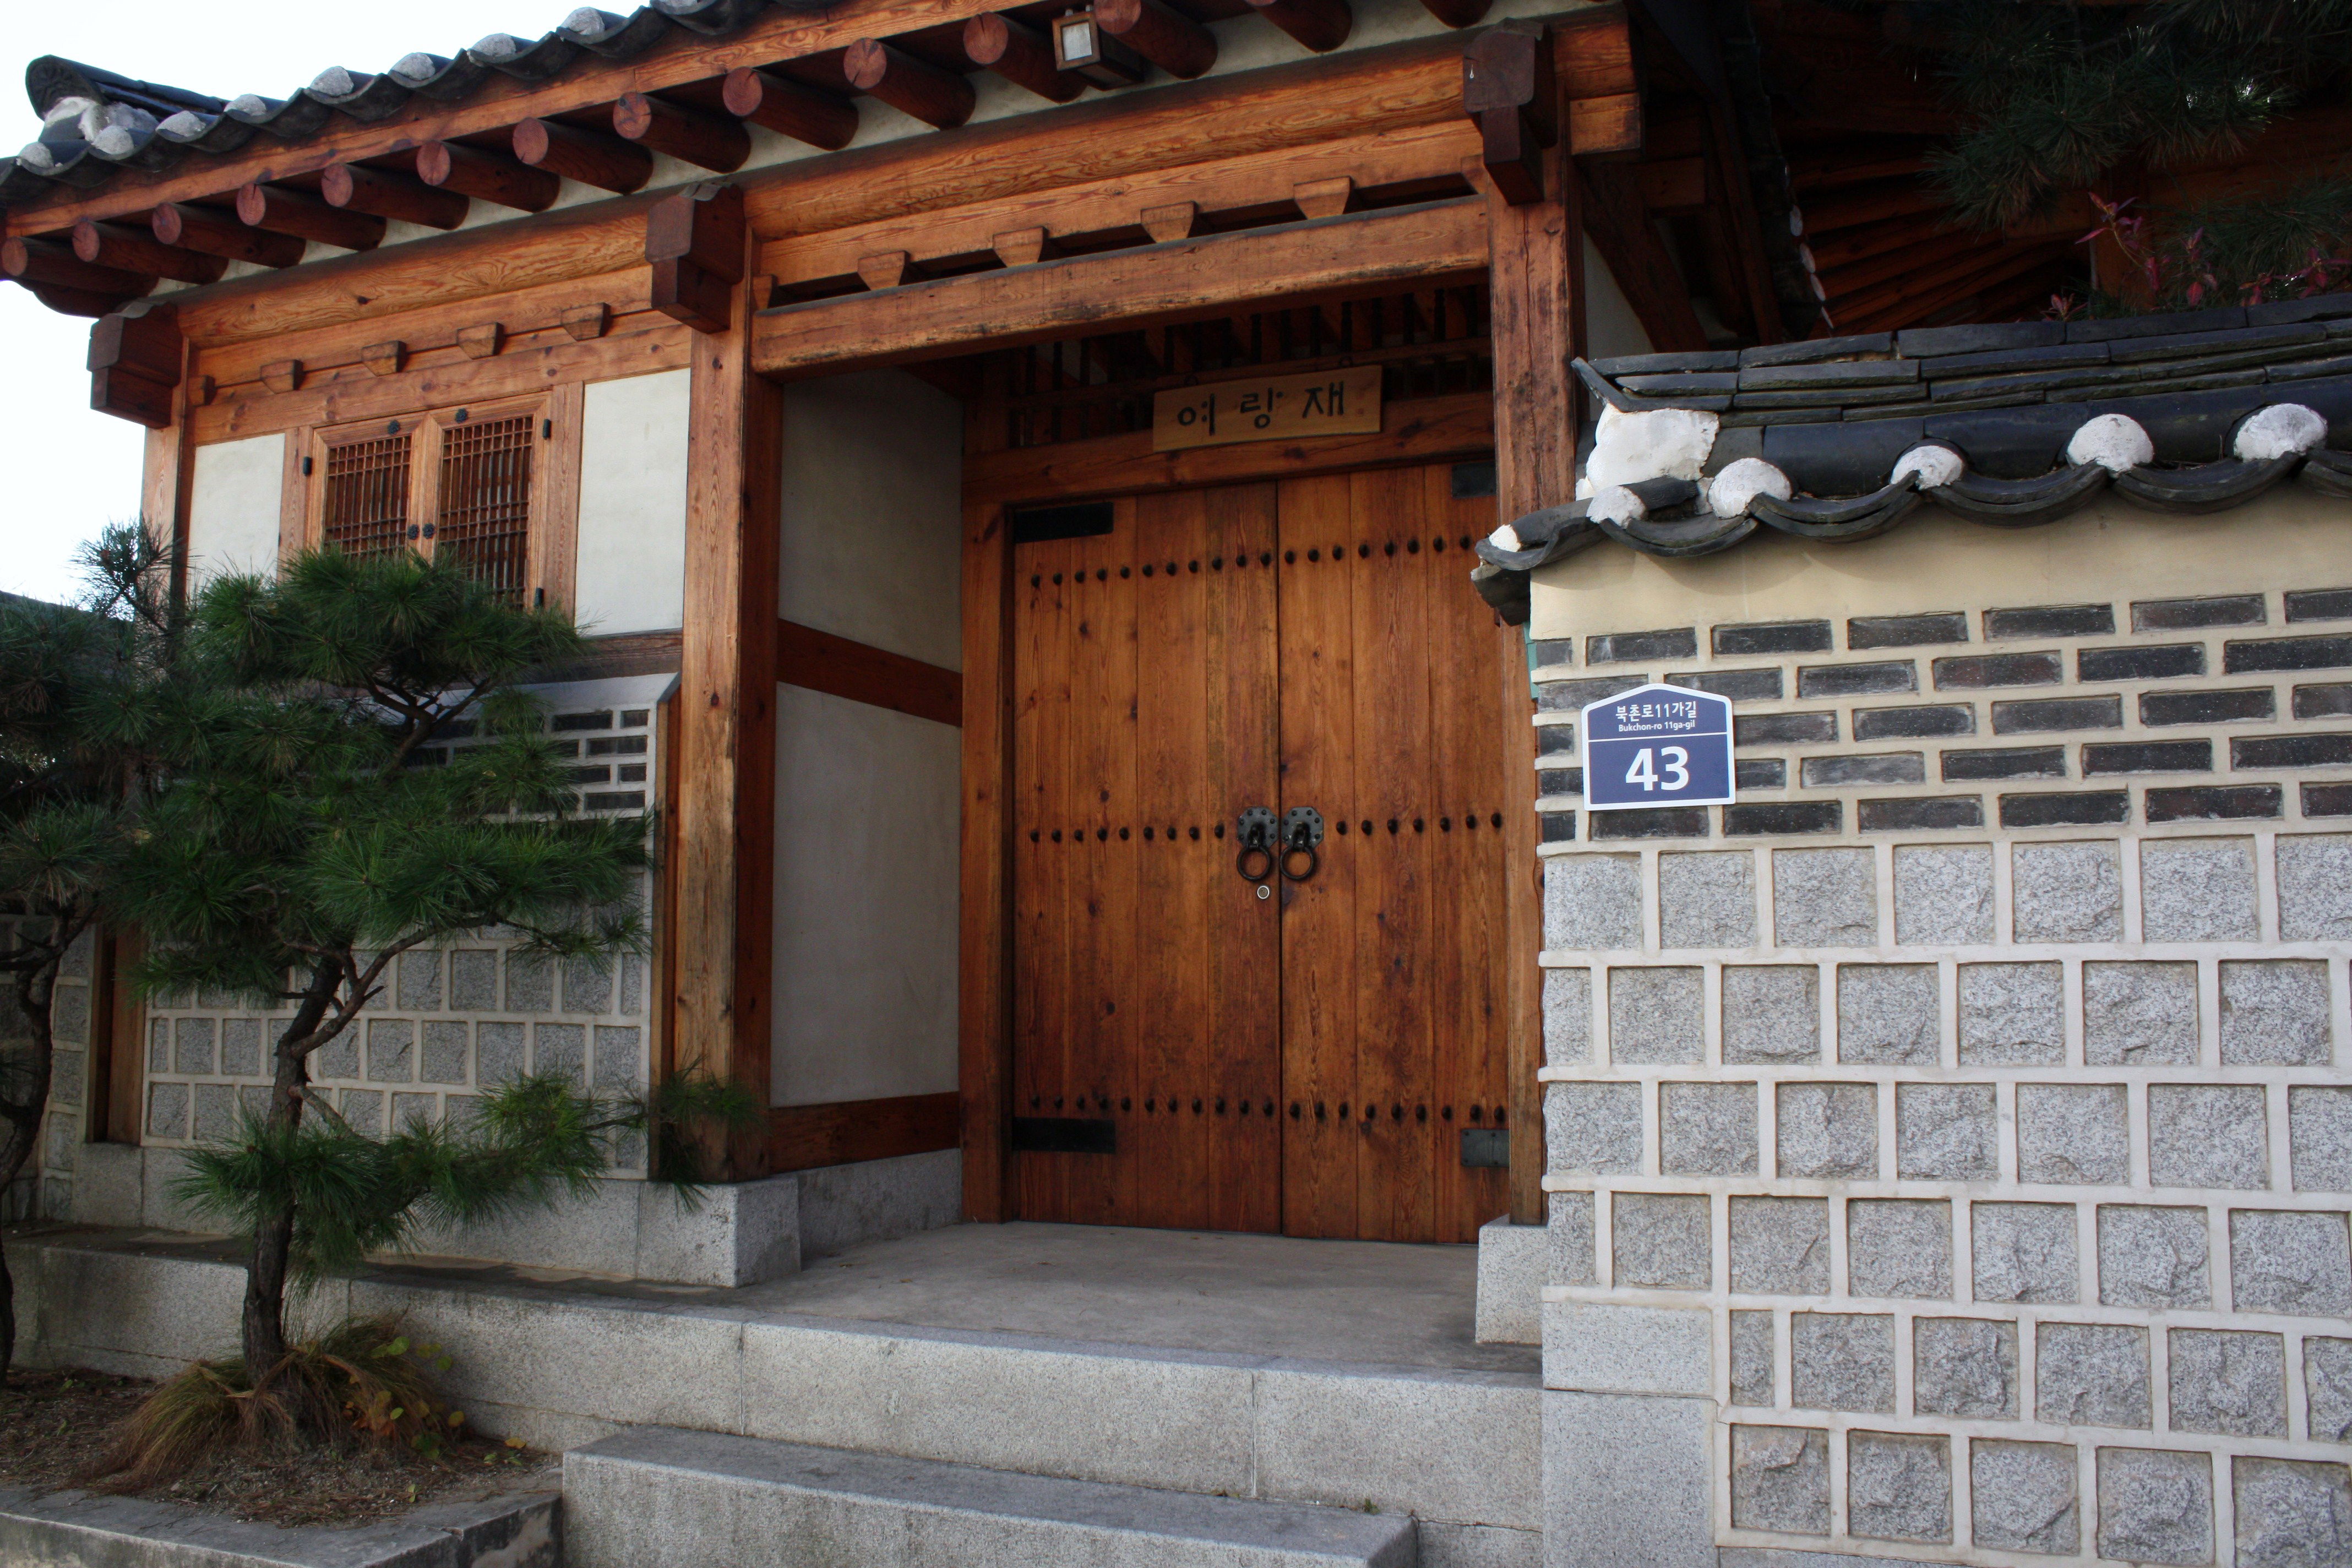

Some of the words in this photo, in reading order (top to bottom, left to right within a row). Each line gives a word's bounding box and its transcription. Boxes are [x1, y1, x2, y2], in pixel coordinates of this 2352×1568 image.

[1615, 701, 1697, 722] 북촌로11가길
[1618, 722, 1662, 732] Bukchon-ro
[1664, 720, 1695, 731] 11ga-gil
[1625, 746, 1689, 791] 43
